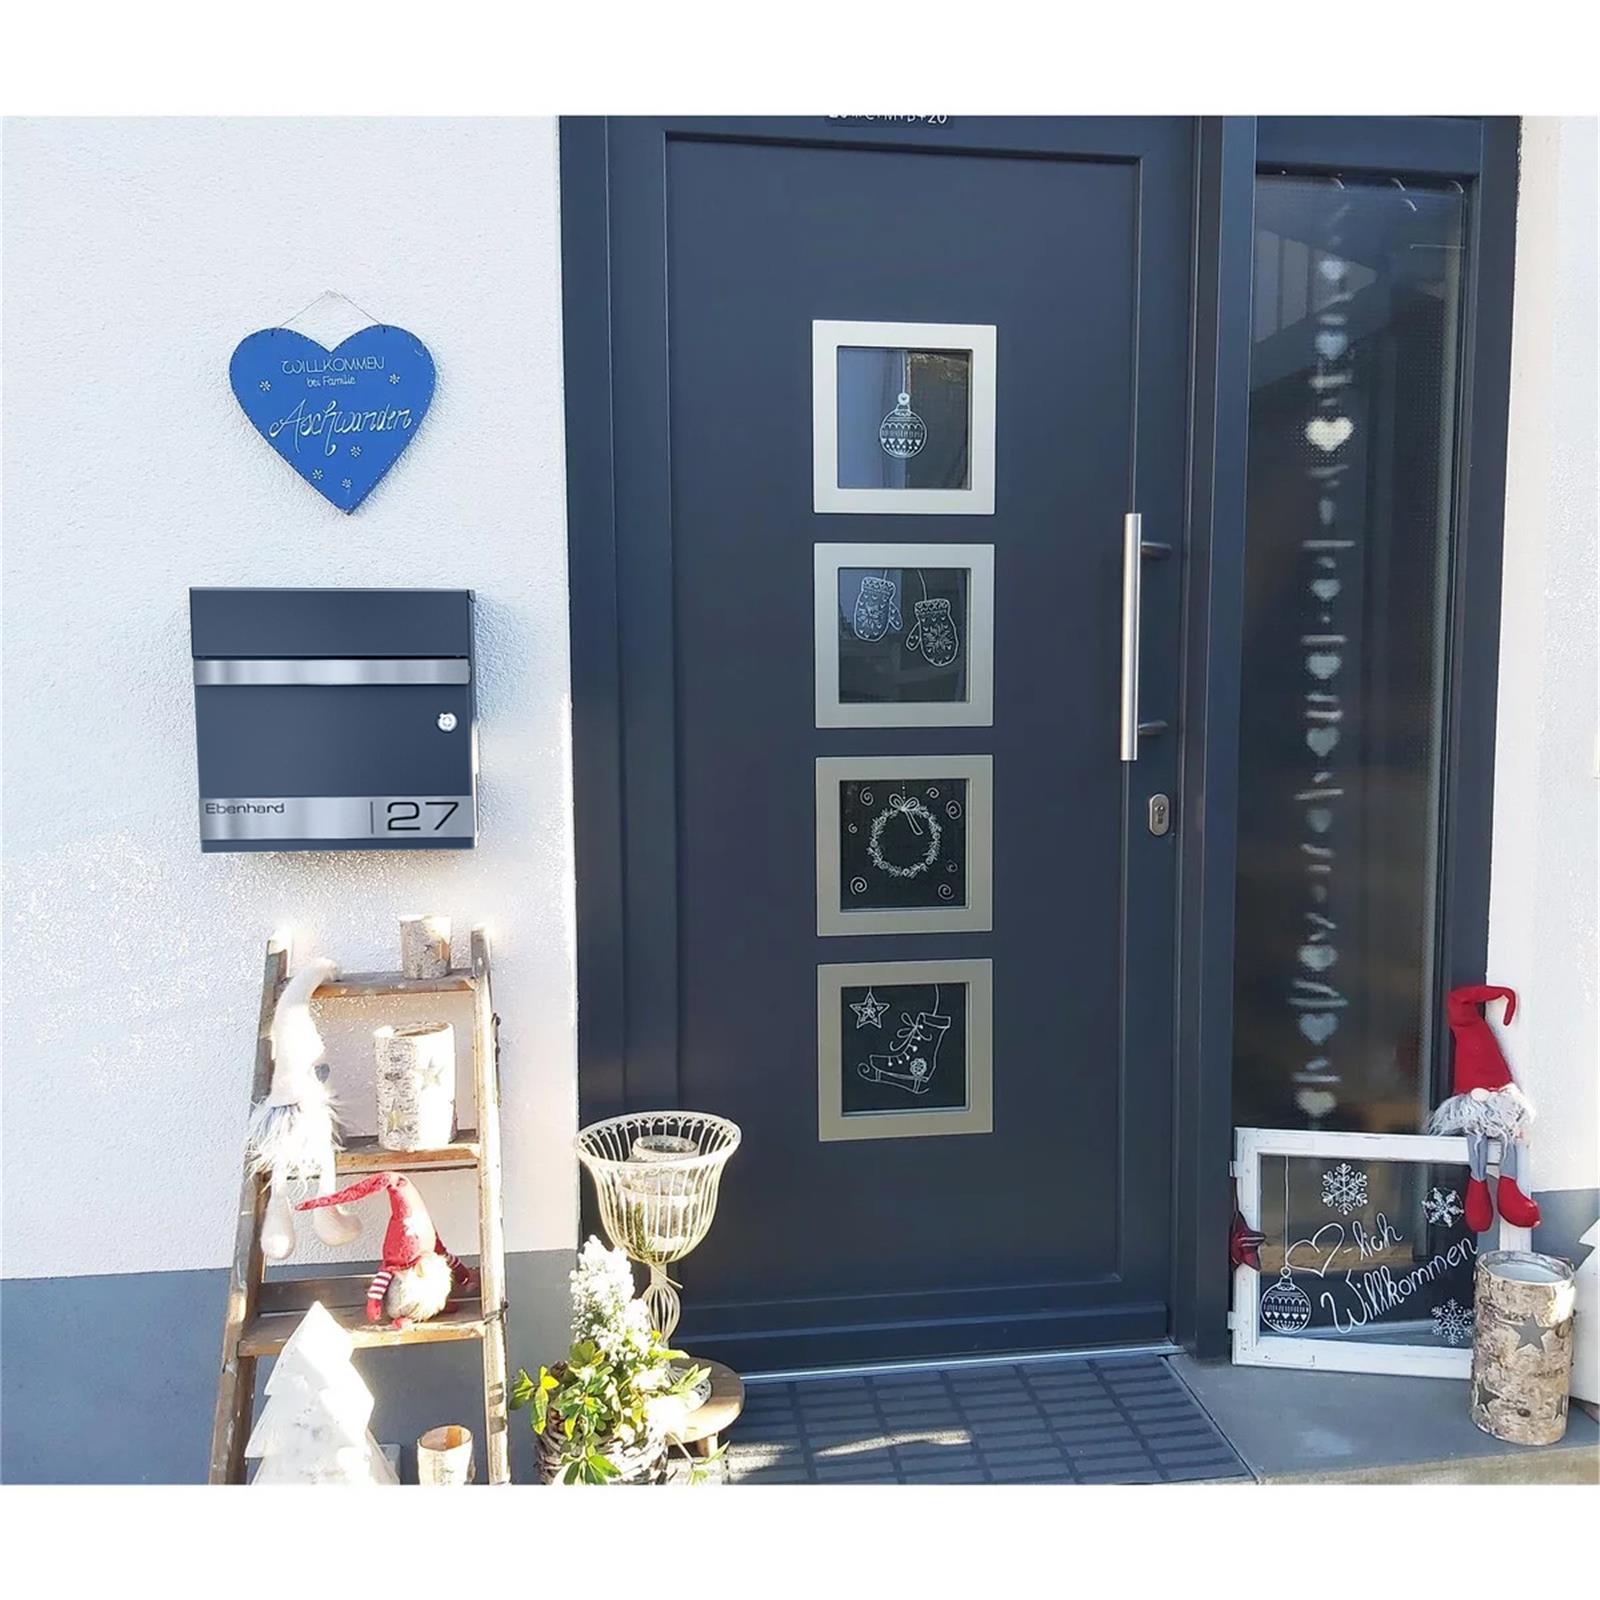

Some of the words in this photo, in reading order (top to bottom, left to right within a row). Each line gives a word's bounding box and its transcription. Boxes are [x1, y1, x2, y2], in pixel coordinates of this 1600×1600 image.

[281, 356, 385, 375] WILLKOMMEN
[306, 375, 320, 388] bei
[322, 375, 357, 387] Familie
[268, 398, 412, 457] Aschwanden
[205, 802, 285, 814] Ebenhard
[386, 801, 460, 831] 27
[1320, 1237, 1479, 1334] Willkommen
